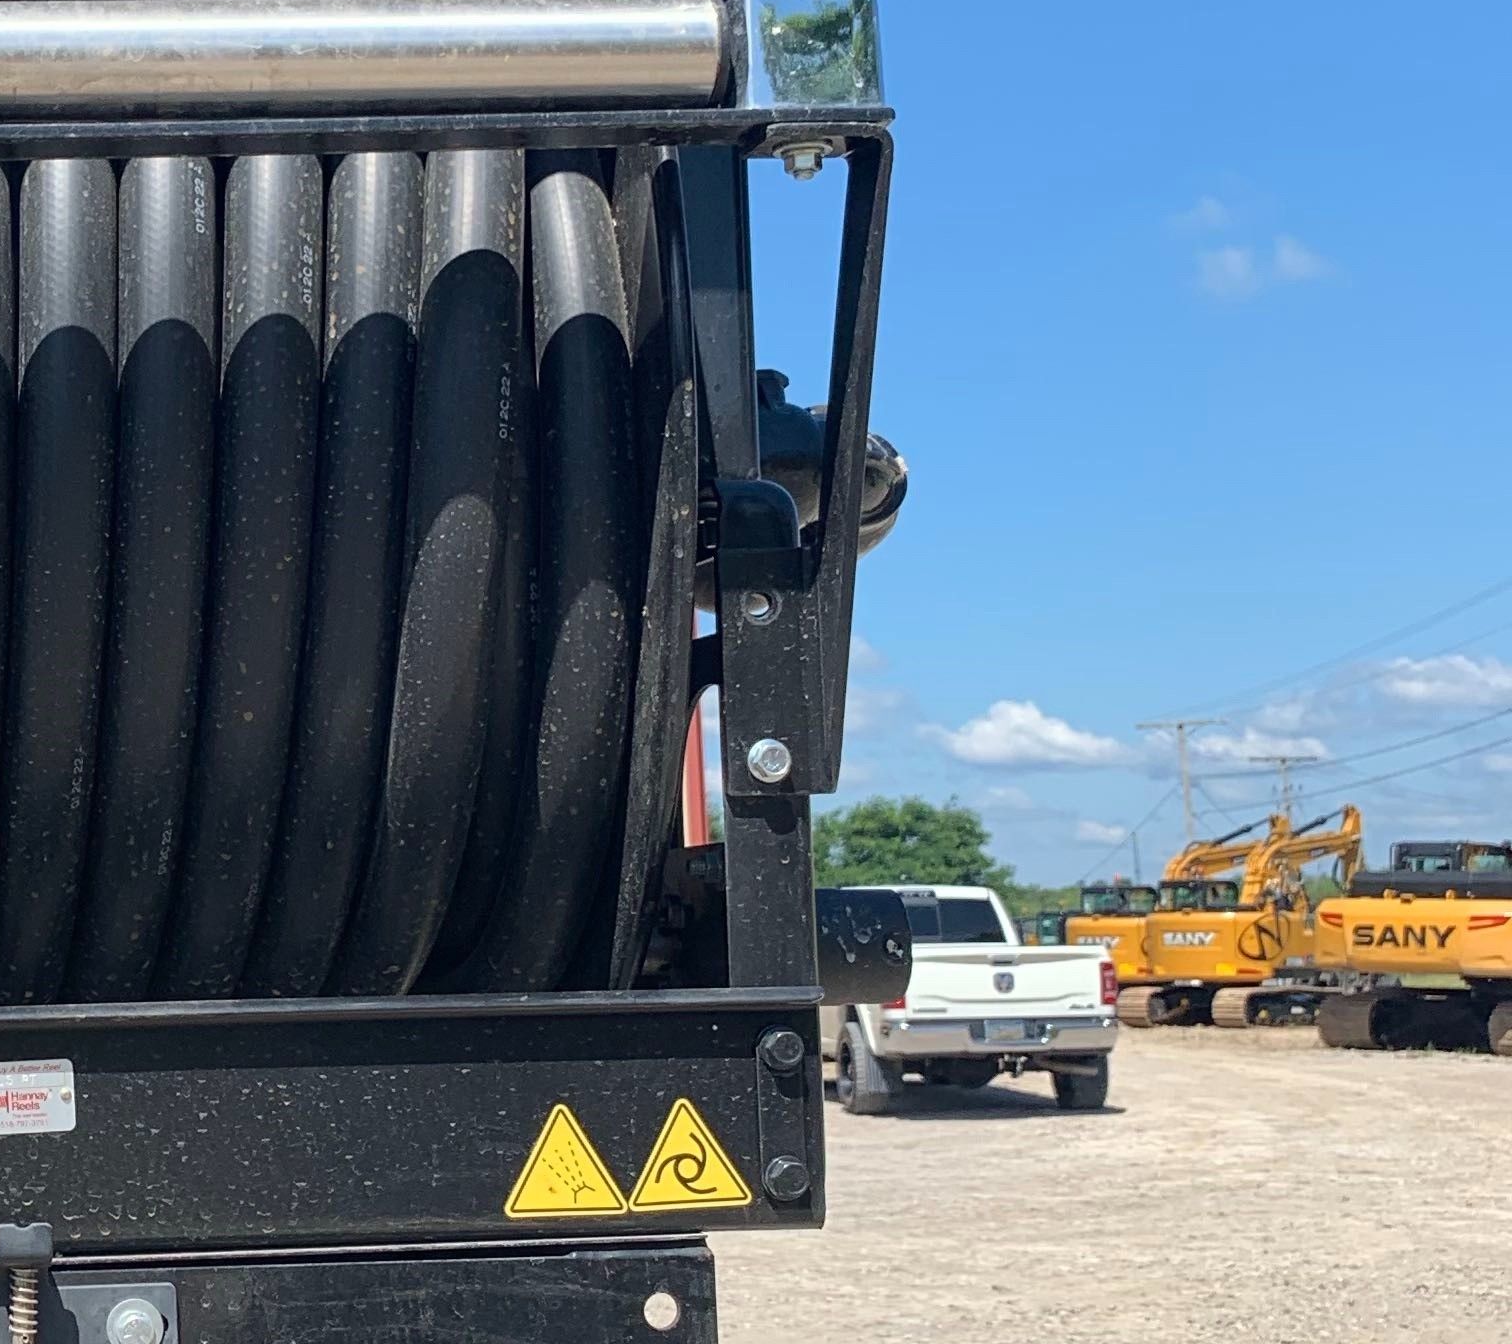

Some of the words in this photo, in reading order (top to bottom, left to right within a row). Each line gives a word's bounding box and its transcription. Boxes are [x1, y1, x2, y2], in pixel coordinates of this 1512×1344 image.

[194, 178, 205, 197] 22
[195, 219, 205, 234] 01
[302, 245, 313, 265] 22
[302, 289, 312, 304] 01
[500, 376, 511, 397] 22
[499, 423, 509, 439] 01
[73, 758, 84, 774] 22
[1163, 931, 1216, 945] SANY
[1353, 923, 1457, 949] SANY
[11, 1089, 47, 1102] Hannay
[11, 1101, 40, 1110] Reels
